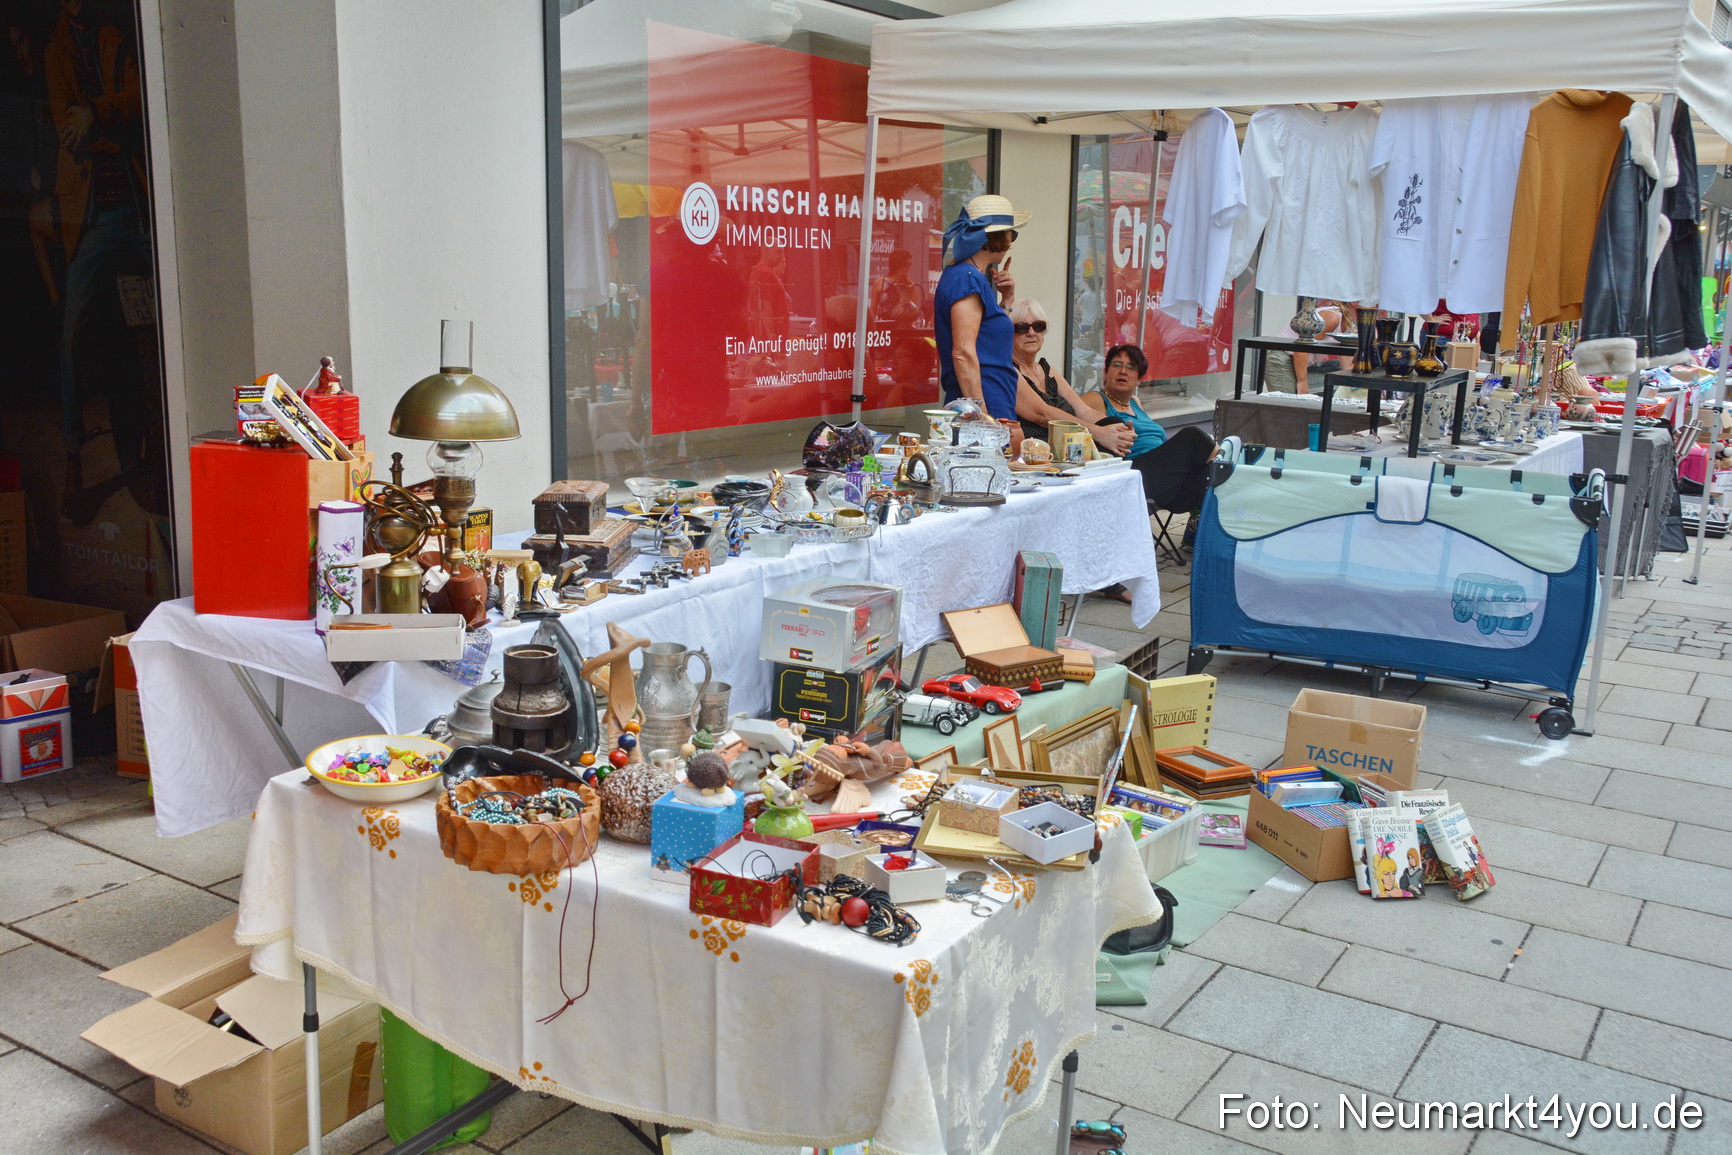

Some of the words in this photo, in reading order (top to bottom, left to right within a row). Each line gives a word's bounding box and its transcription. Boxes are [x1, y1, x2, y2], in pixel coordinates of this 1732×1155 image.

[726, 184, 810, 216] KIRSCH
[817, 192, 830, 217] &
[835, 193, 924, 223] HABNER
[691, 209, 709, 227] KH
[726, 223, 831, 249] IMMOBILIEN
[1115, 289, 1132, 310] Die
[725, 336, 745, 355] Ein
[748, 334, 782, 354] Anruf
[785, 333, 828, 357] genügt!
[63, 542, 98, 562] TOM
[100, 549, 161, 574] TAILOR
[1153, 709, 1197, 725] STROLOGIE
[1306, 745, 1394, 774] TASCHEN
[1401, 800, 1411, 808] Die
